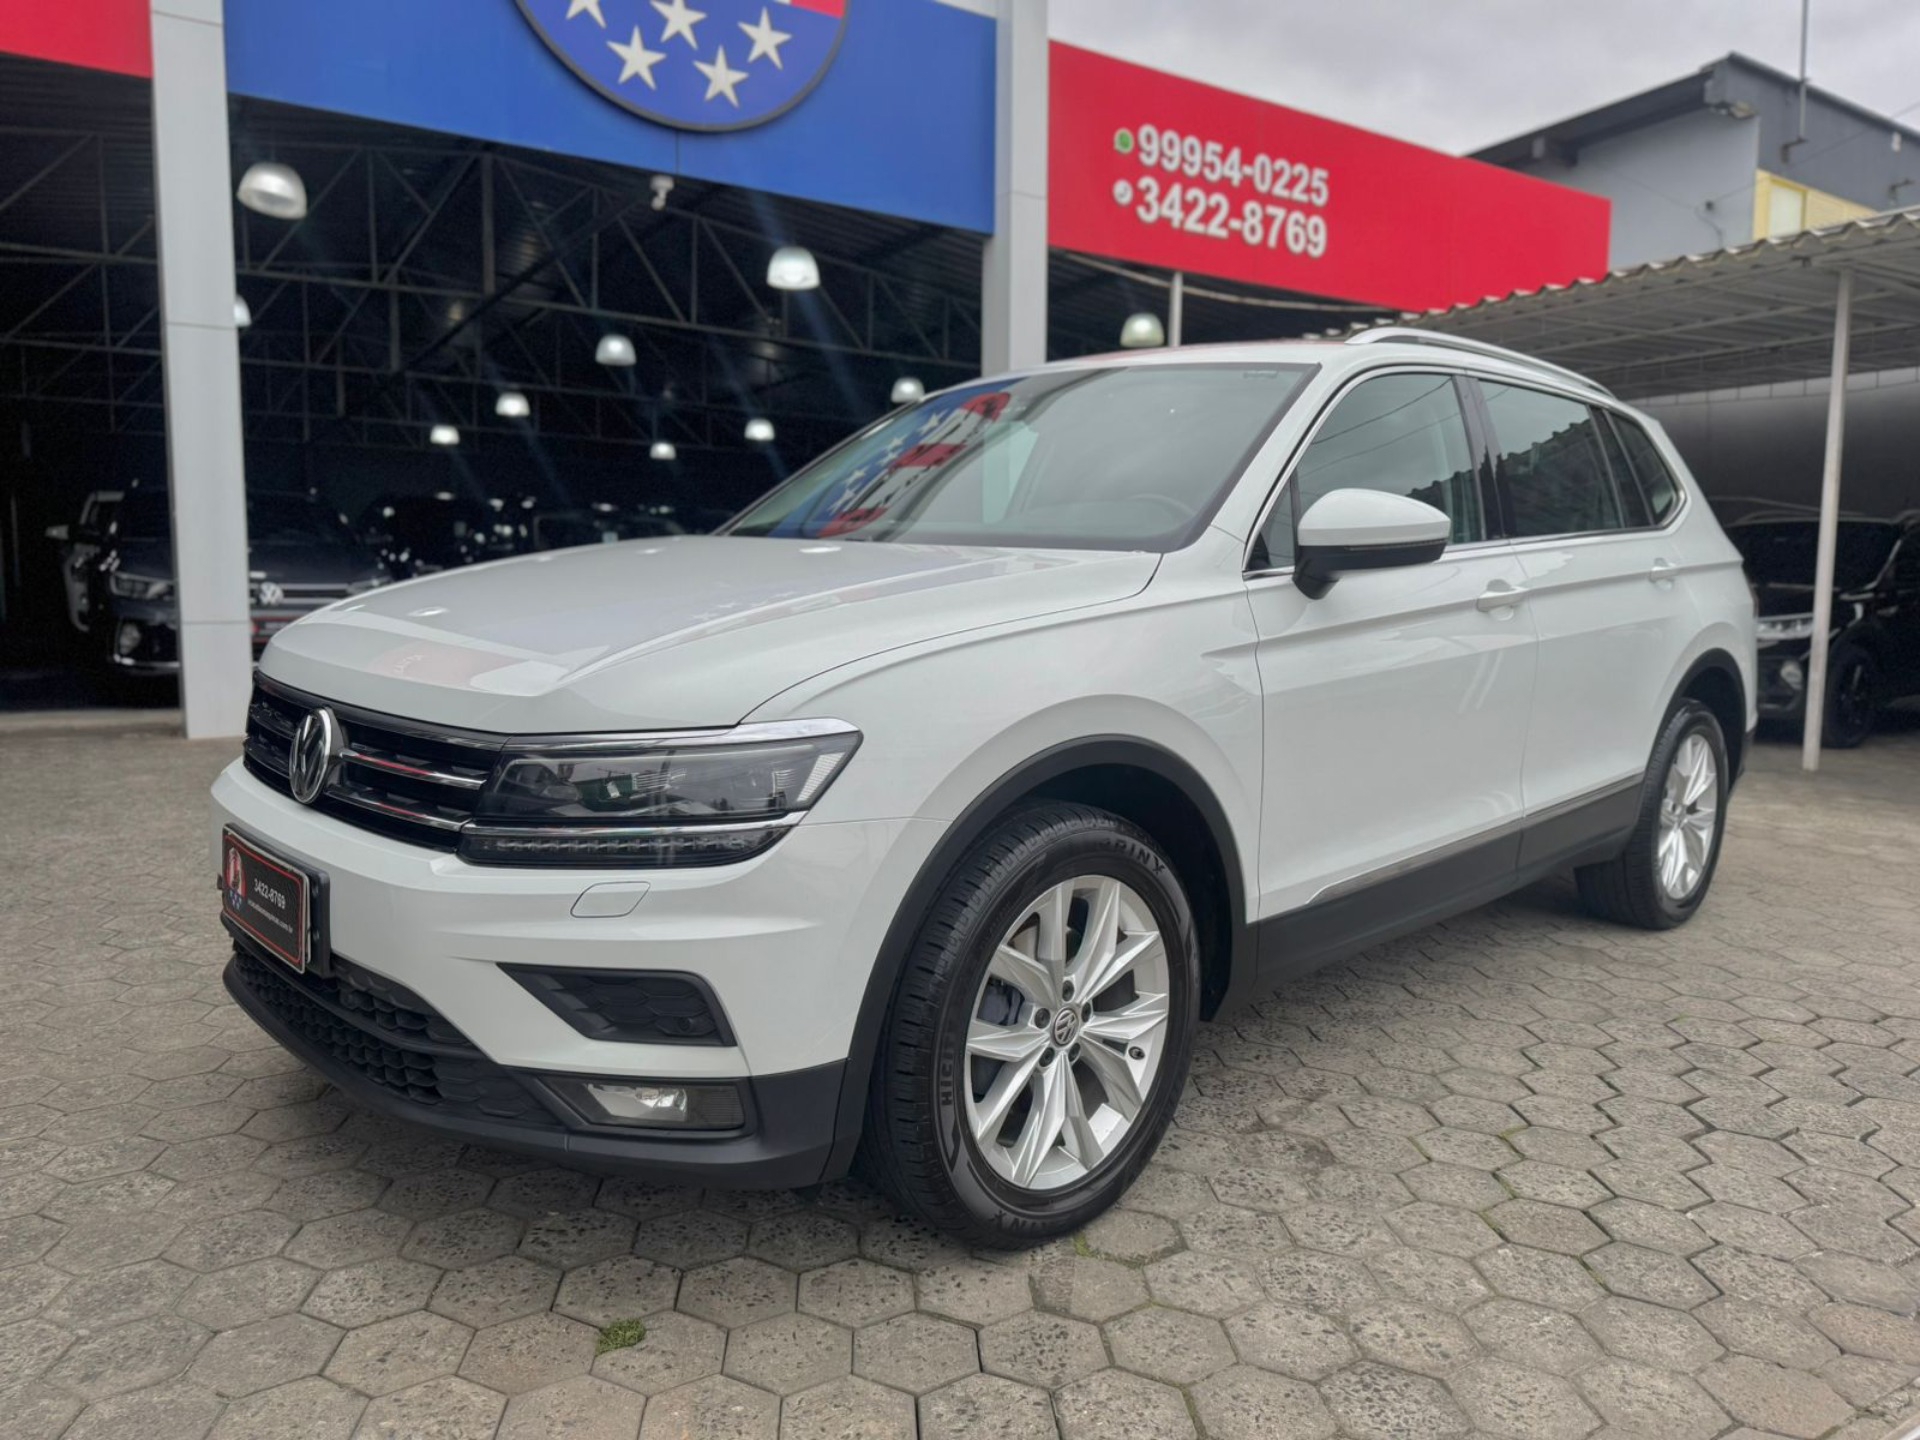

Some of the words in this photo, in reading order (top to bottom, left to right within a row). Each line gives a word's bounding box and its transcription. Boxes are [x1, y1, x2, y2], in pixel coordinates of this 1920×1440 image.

[1137, 123, 1329, 207] 99954-0225
[1136, 176, 1328, 259] 3422-8769
[253, 878, 286, 910] 3422-8769
